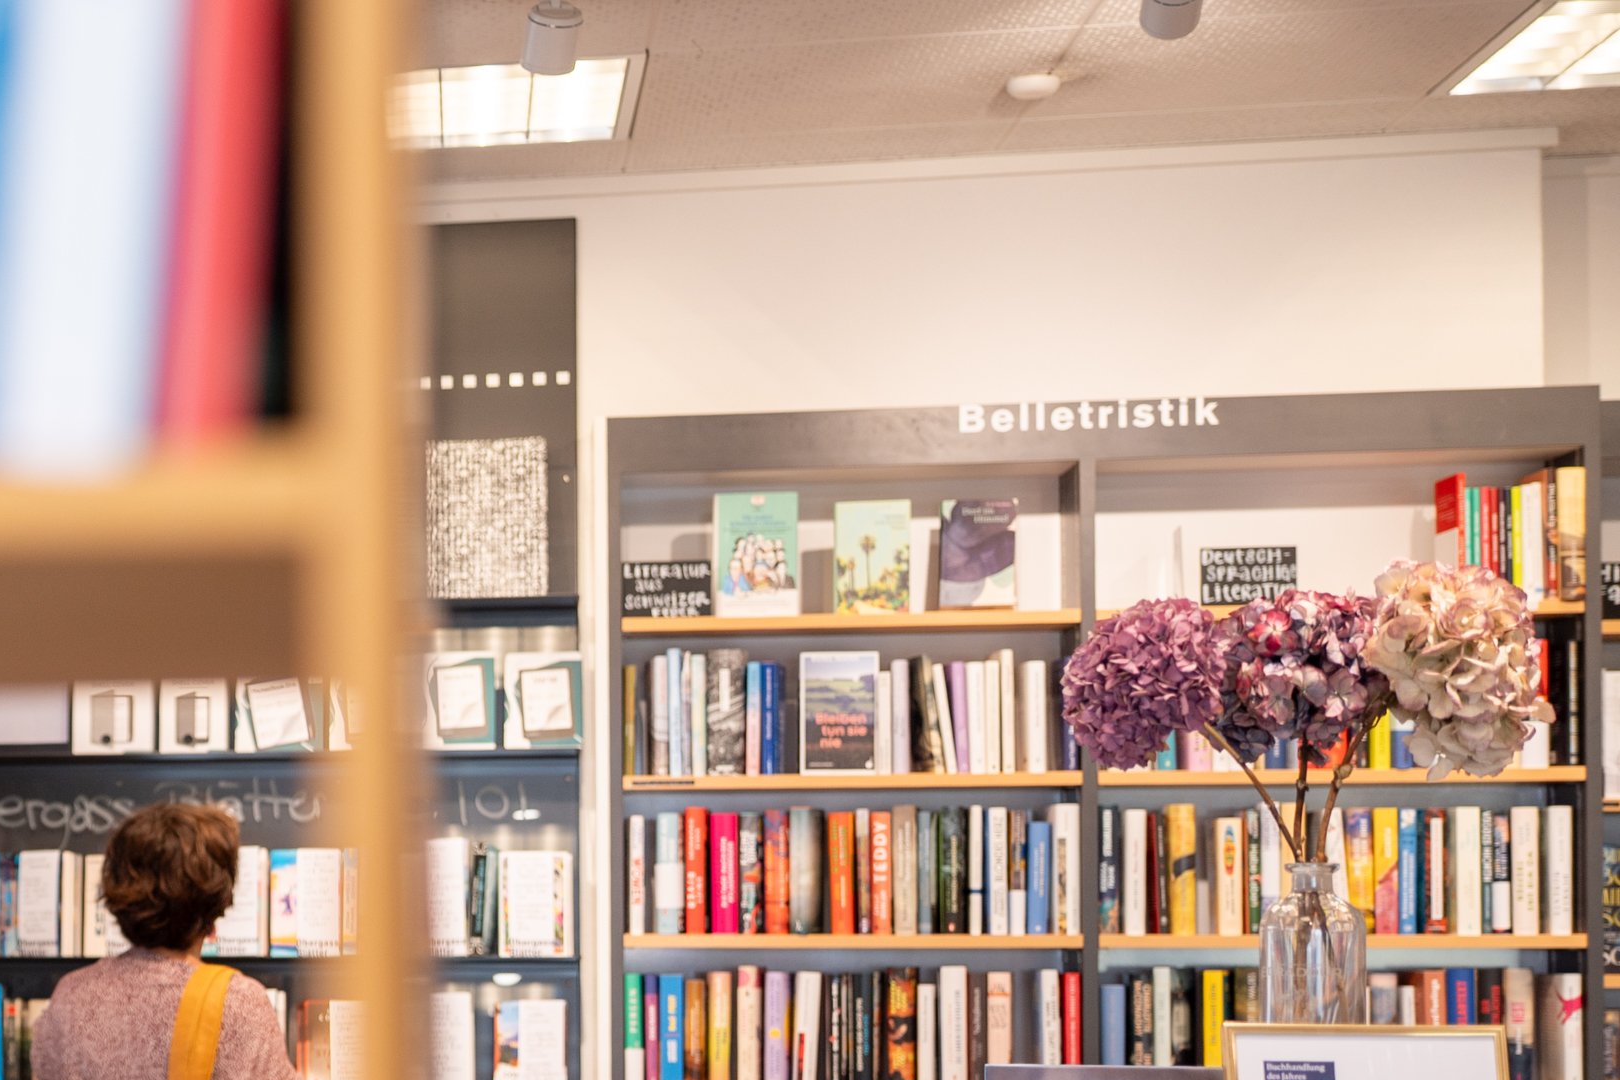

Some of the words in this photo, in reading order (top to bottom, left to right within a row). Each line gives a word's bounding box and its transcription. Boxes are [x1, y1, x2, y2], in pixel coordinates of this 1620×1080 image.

[958, 397, 1219, 433] Belletristik
[872, 820, 888, 884] TEDDY
[1266, 1063, 1326, 1073] Buchhandlung
[1266, 1073, 1280, 1080] des
